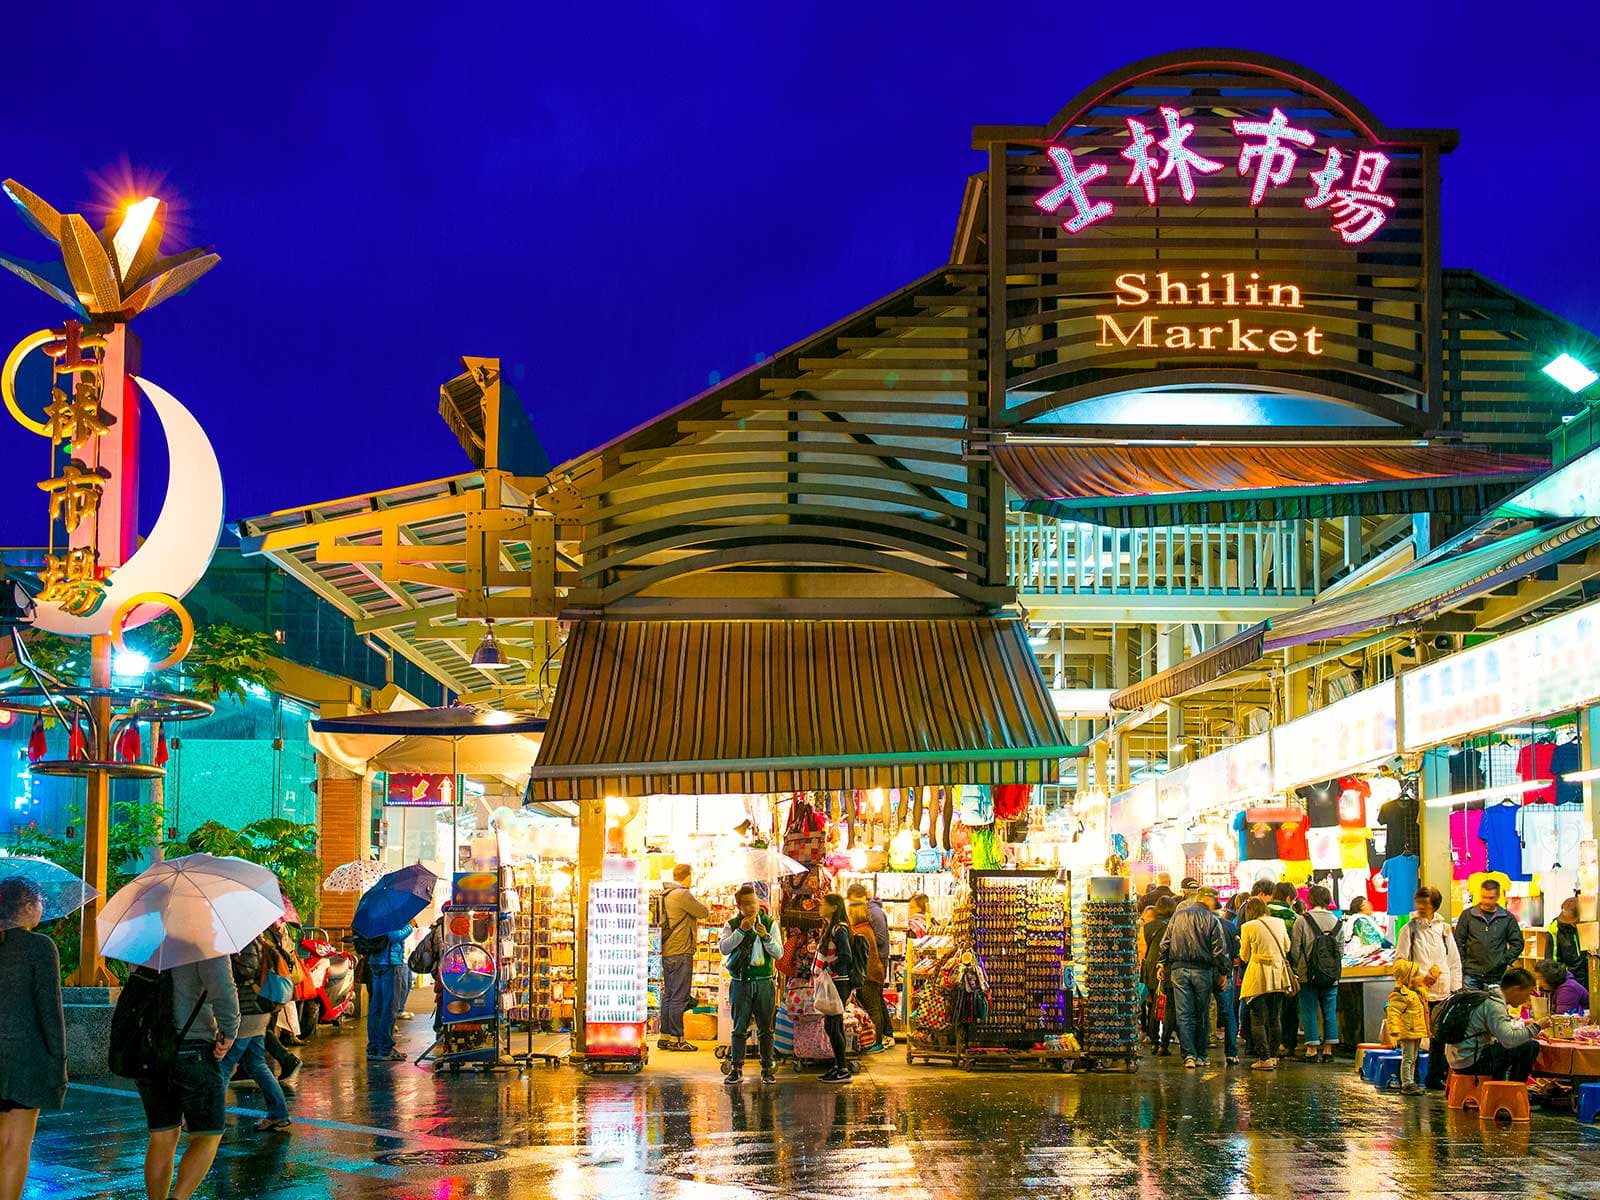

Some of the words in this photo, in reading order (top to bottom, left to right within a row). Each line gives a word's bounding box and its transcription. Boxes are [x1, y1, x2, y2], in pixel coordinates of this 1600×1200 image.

[1035, 106, 1396, 245] 士林市場
[1095, 314, 1324, 355] Market
[1114, 271, 1304, 308] Shilin
[36, 319, 109, 618] 士林市場
